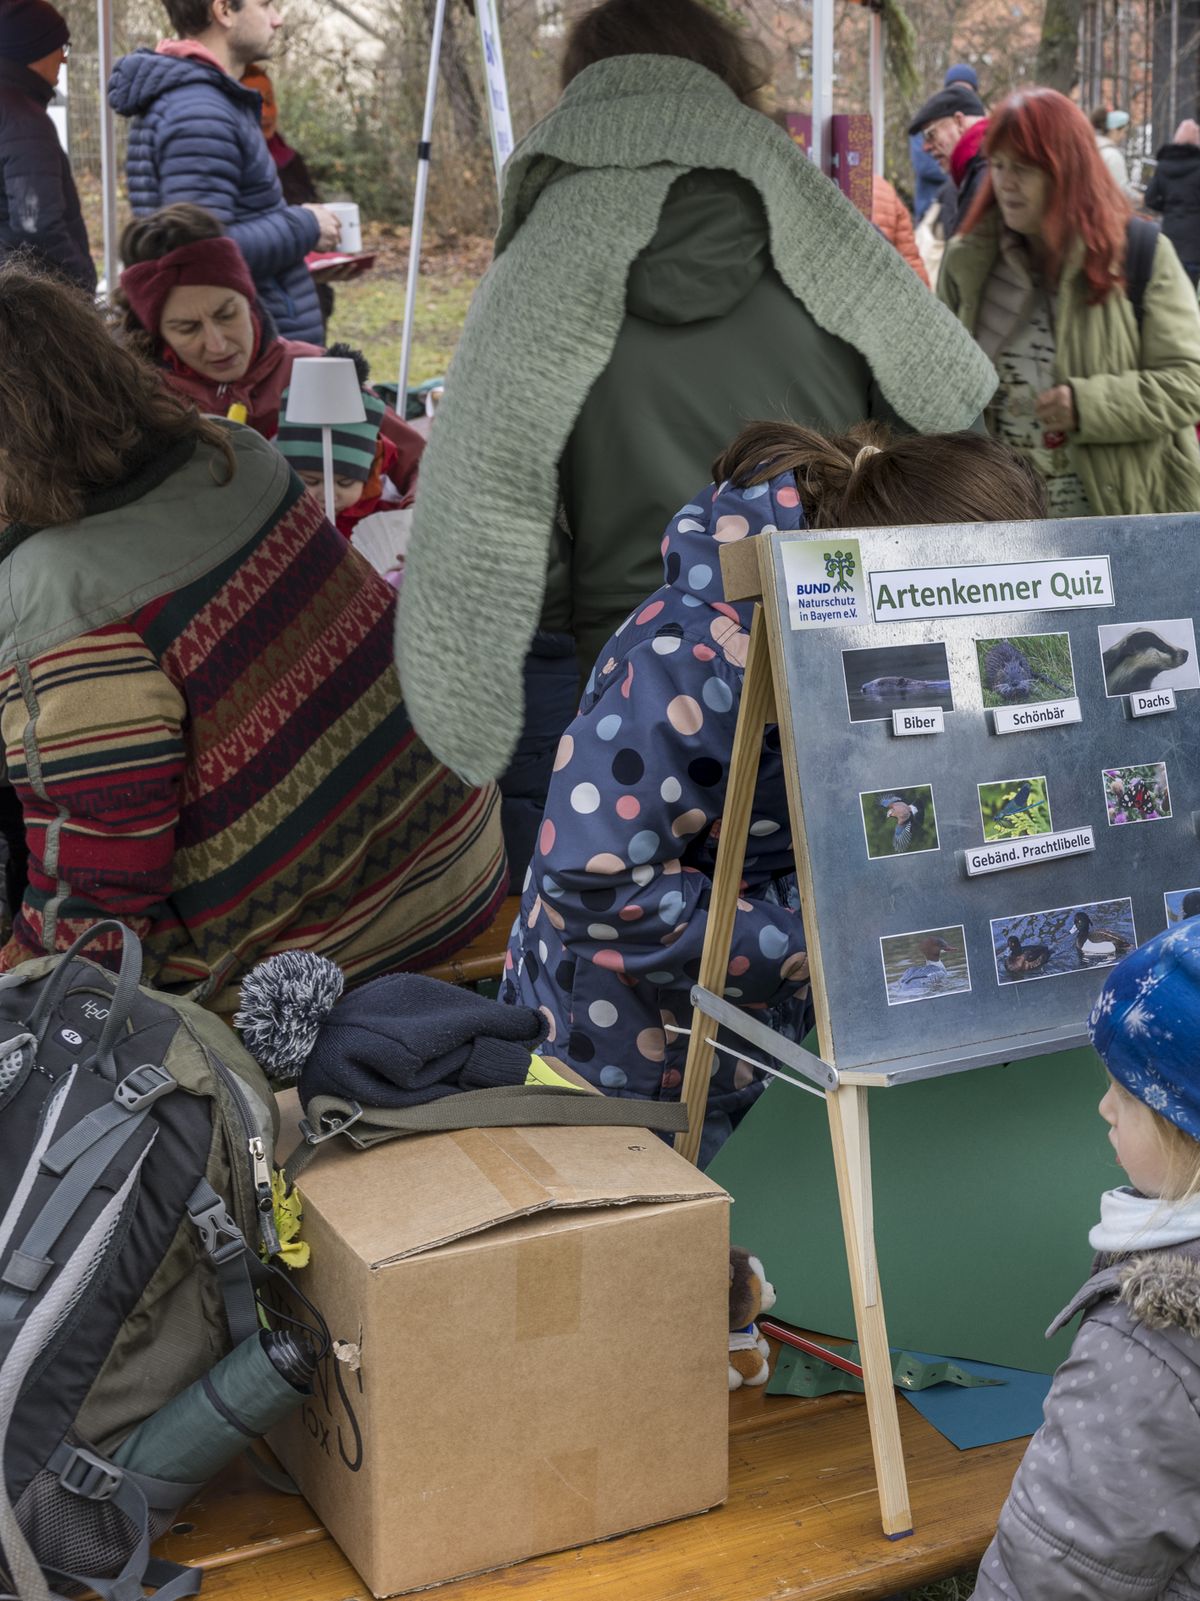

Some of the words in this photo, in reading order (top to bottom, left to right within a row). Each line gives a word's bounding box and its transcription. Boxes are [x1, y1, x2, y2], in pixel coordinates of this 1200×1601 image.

[797, 583, 831, 595] BUND
[876, 578, 1042, 610] Artenkenner
[1050, 570, 1104, 600] Quiz
[798, 596, 856, 609] Naturschutz
[800, 611, 809, 621] in
[810, 610, 842, 622] Bayern
[843, 608, 858, 619] e.V.
[1138, 693, 1170, 710] Dachs
[903, 714, 936, 730] Biber
[1012, 707, 1065, 726] Schönbär
[971, 846, 1020, 869] Gebänd.
[1022, 832, 1091, 859] Prachtlibelle
